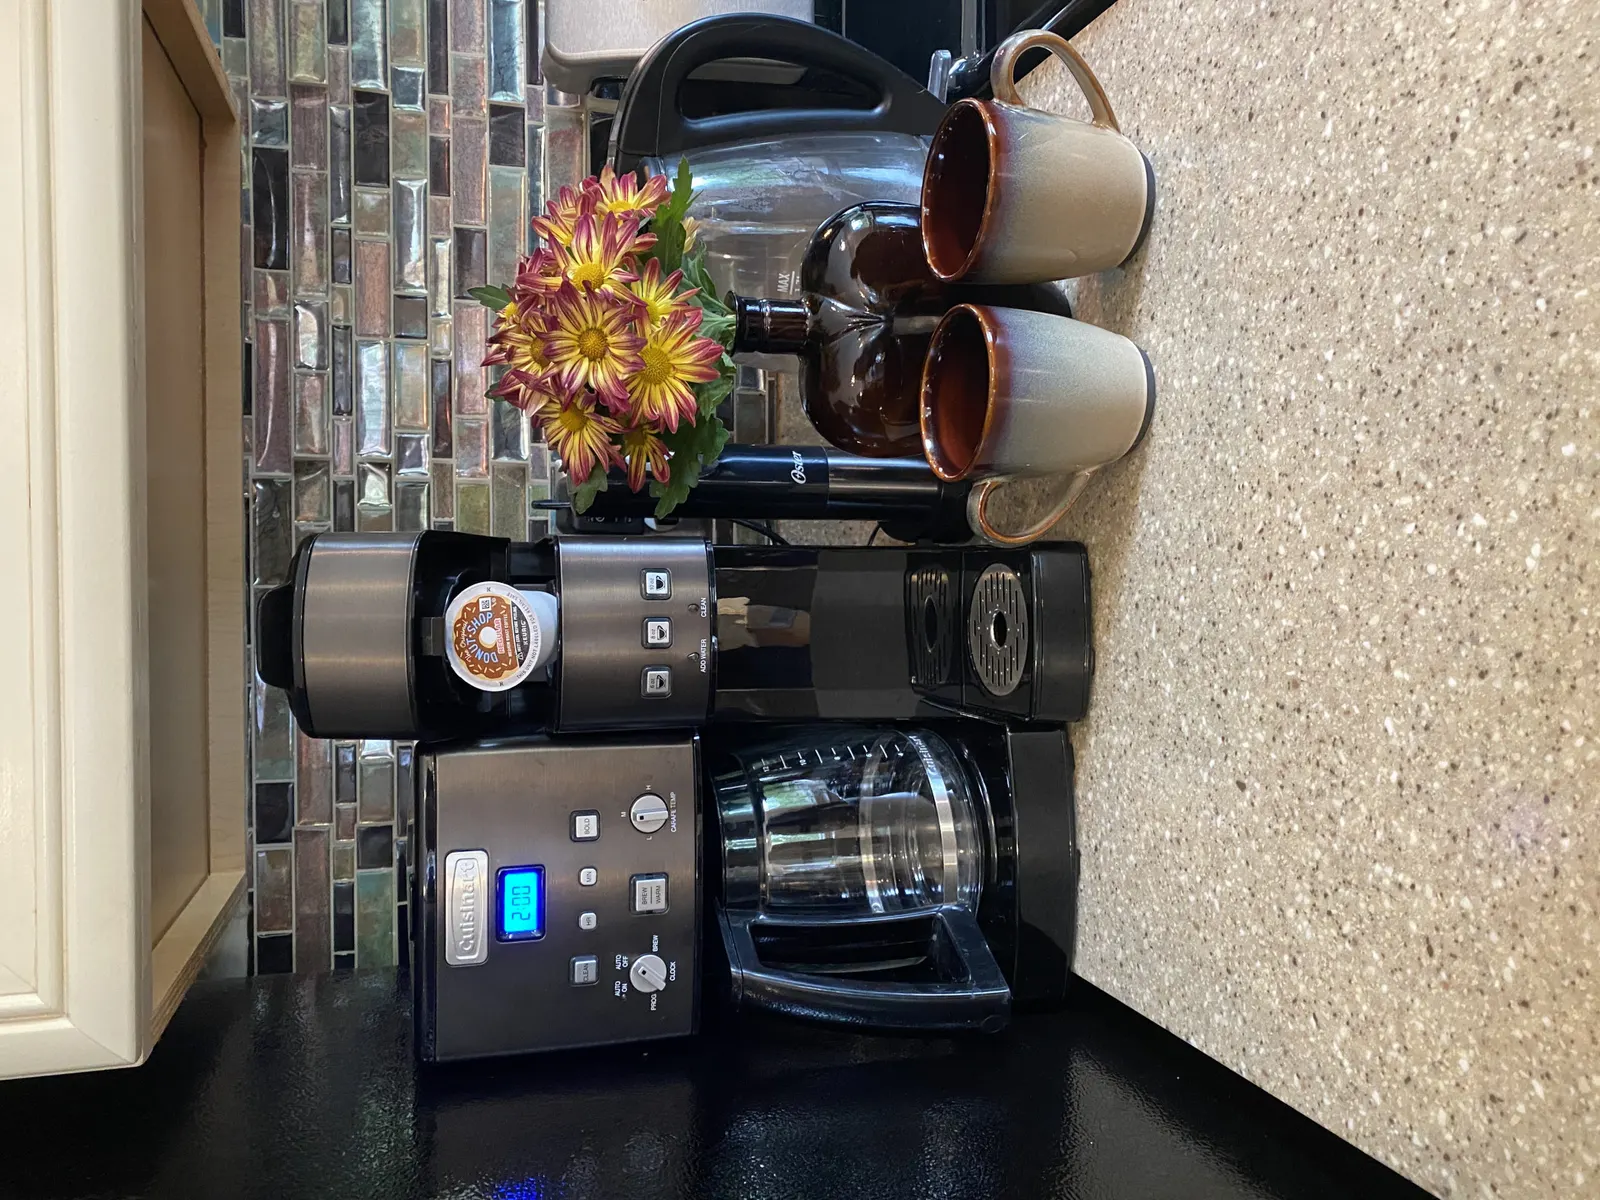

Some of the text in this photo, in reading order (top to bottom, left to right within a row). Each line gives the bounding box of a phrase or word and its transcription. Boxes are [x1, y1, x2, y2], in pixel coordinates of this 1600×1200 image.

[777, 273, 790, 292] MAX
[790, 450, 807, 484] Oster
[460, 619, 468, 648] Original
[466, 612, 498, 663] DONUT SHOP
[495, 619, 504, 653] REGULAR
[525, 659, 534, 670] UNIT
[909, 735, 938, 775] Cuisinart
[458, 861, 475, 951] Cuisinart
[512, 885, 531, 921] 2:00
[585, 916, 592, 926] HR
[582, 963, 590, 982] CLEAN
[621, 983, 628, 992] ON
